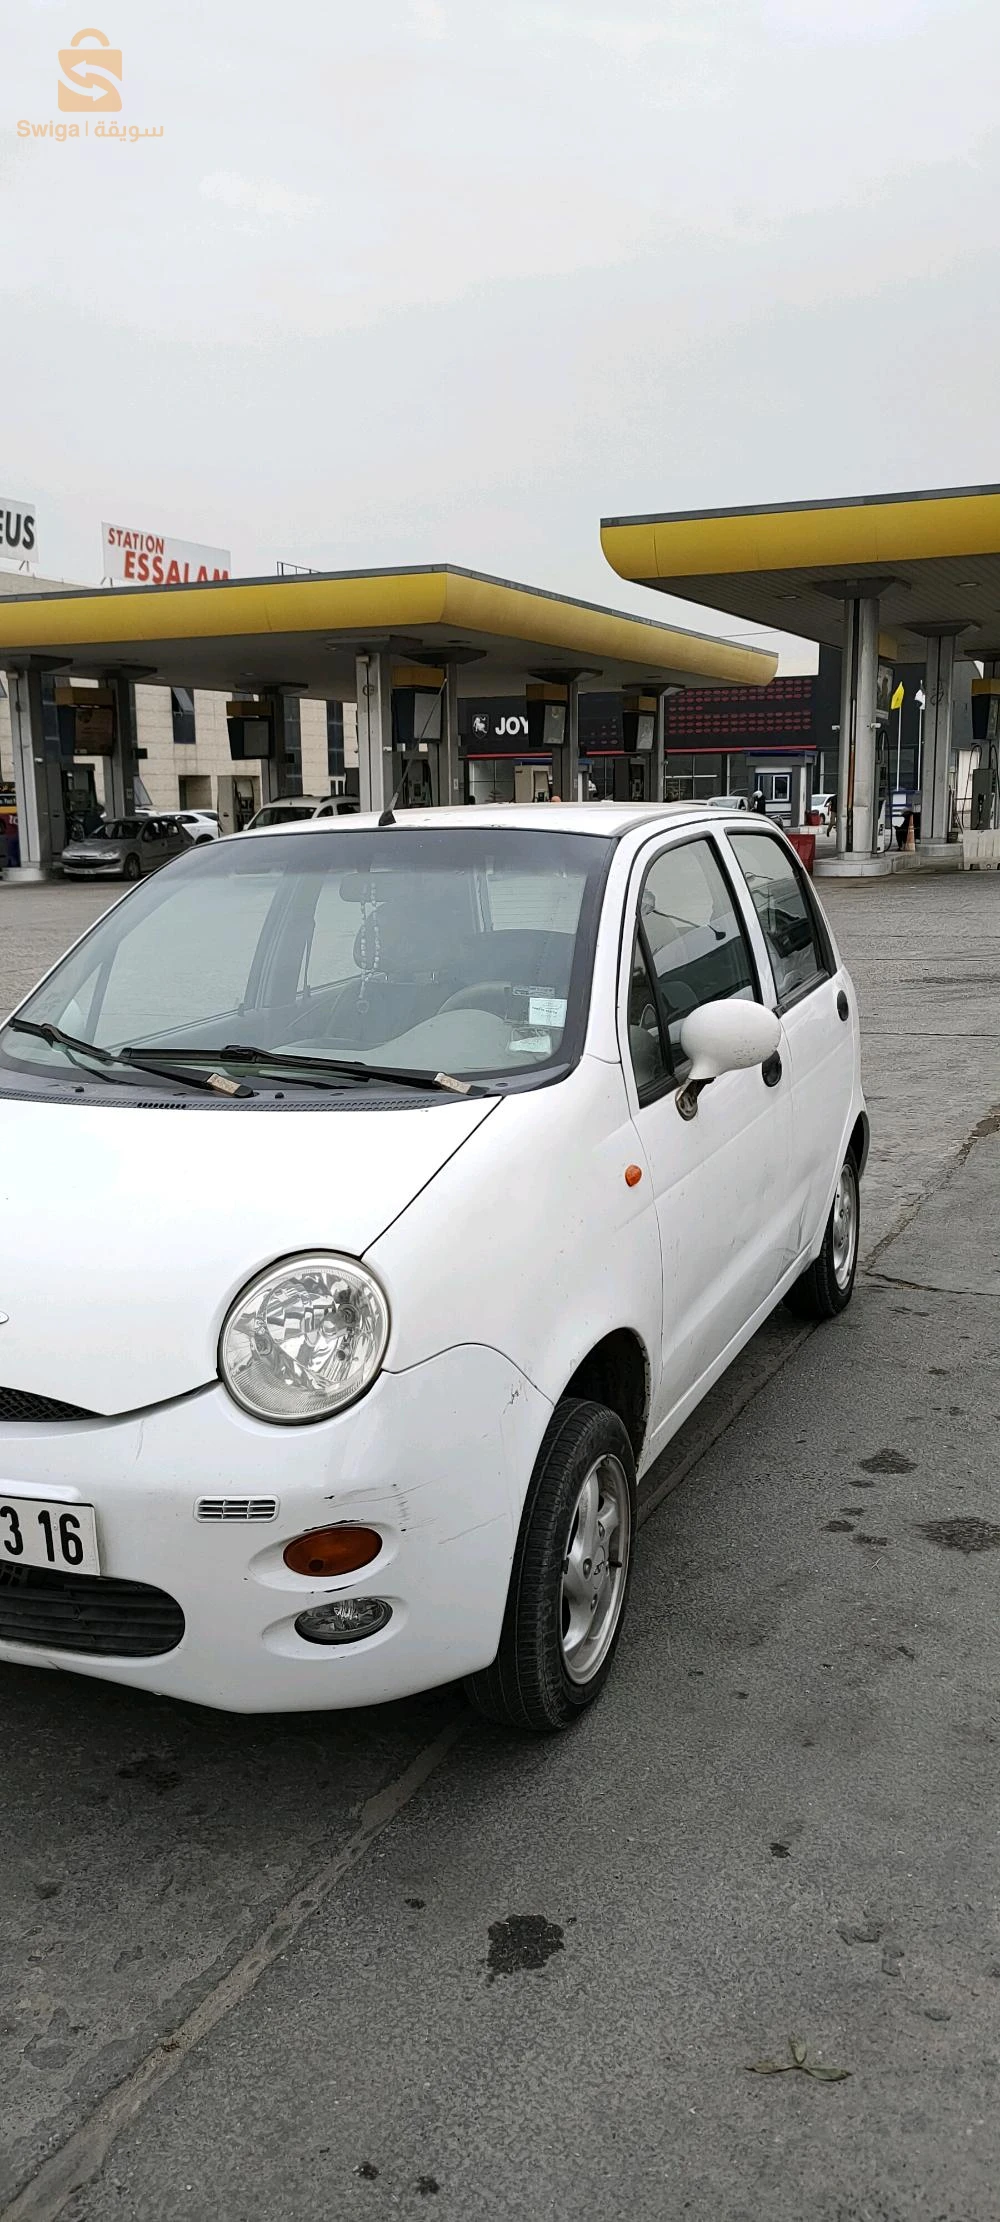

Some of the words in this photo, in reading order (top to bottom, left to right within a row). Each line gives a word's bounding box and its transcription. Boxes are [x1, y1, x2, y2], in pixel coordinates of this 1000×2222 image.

[108, 527, 164, 555] STATION
[0, 1505, 23, 1556] 3
[38, 1509, 84, 1565] 16
